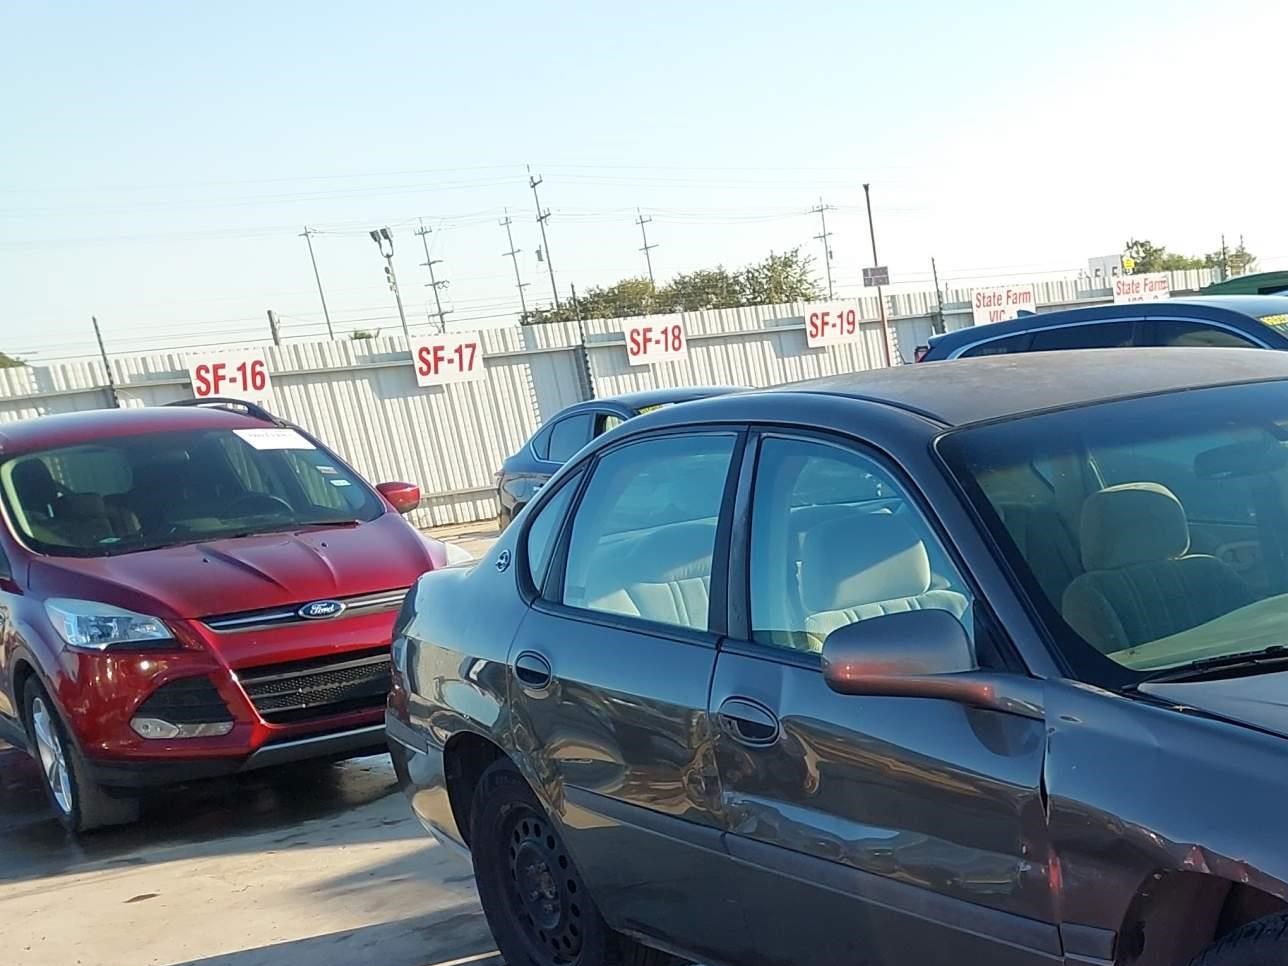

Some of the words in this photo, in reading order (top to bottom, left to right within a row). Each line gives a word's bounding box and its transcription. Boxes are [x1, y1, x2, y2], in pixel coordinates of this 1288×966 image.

[976, 292, 1003, 308] State
[1006, 289, 1031, 305] Farm
[1116, 279, 1140, 296] State
[1143, 277, 1168, 293] Farm
[808, 309, 857, 338] SF-19
[628, 324, 683, 356] SF-18
[418, 343, 477, 377] SF-17
[195, 359, 266, 397] SF-16
[310, 602, 335, 616] Ford
